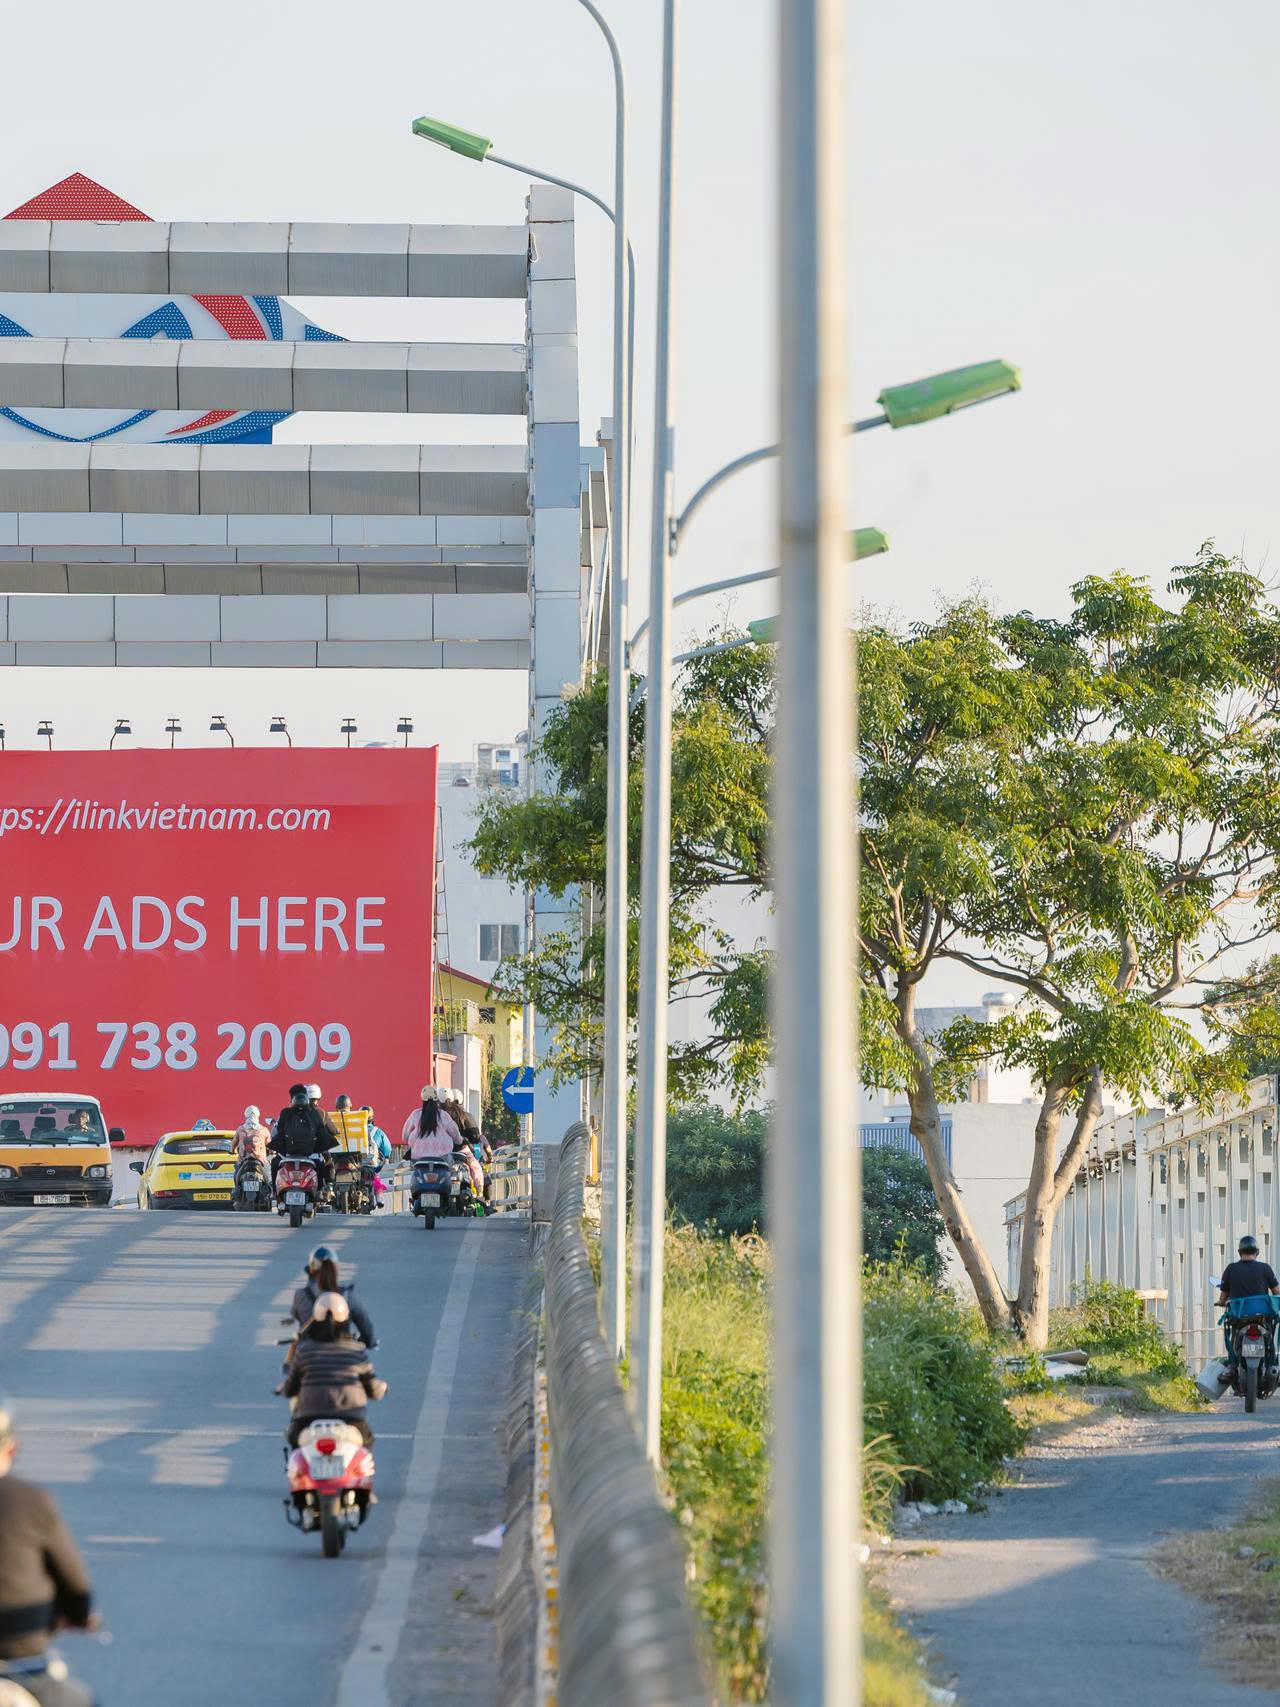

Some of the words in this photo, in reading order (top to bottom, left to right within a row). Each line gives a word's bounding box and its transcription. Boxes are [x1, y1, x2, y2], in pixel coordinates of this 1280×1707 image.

[84, 896, 207, 951] ADS
[230, 896, 386, 952] HERE
[97, 1021, 199, 1071] 738
[215, 1021, 353, 1072] 2009
